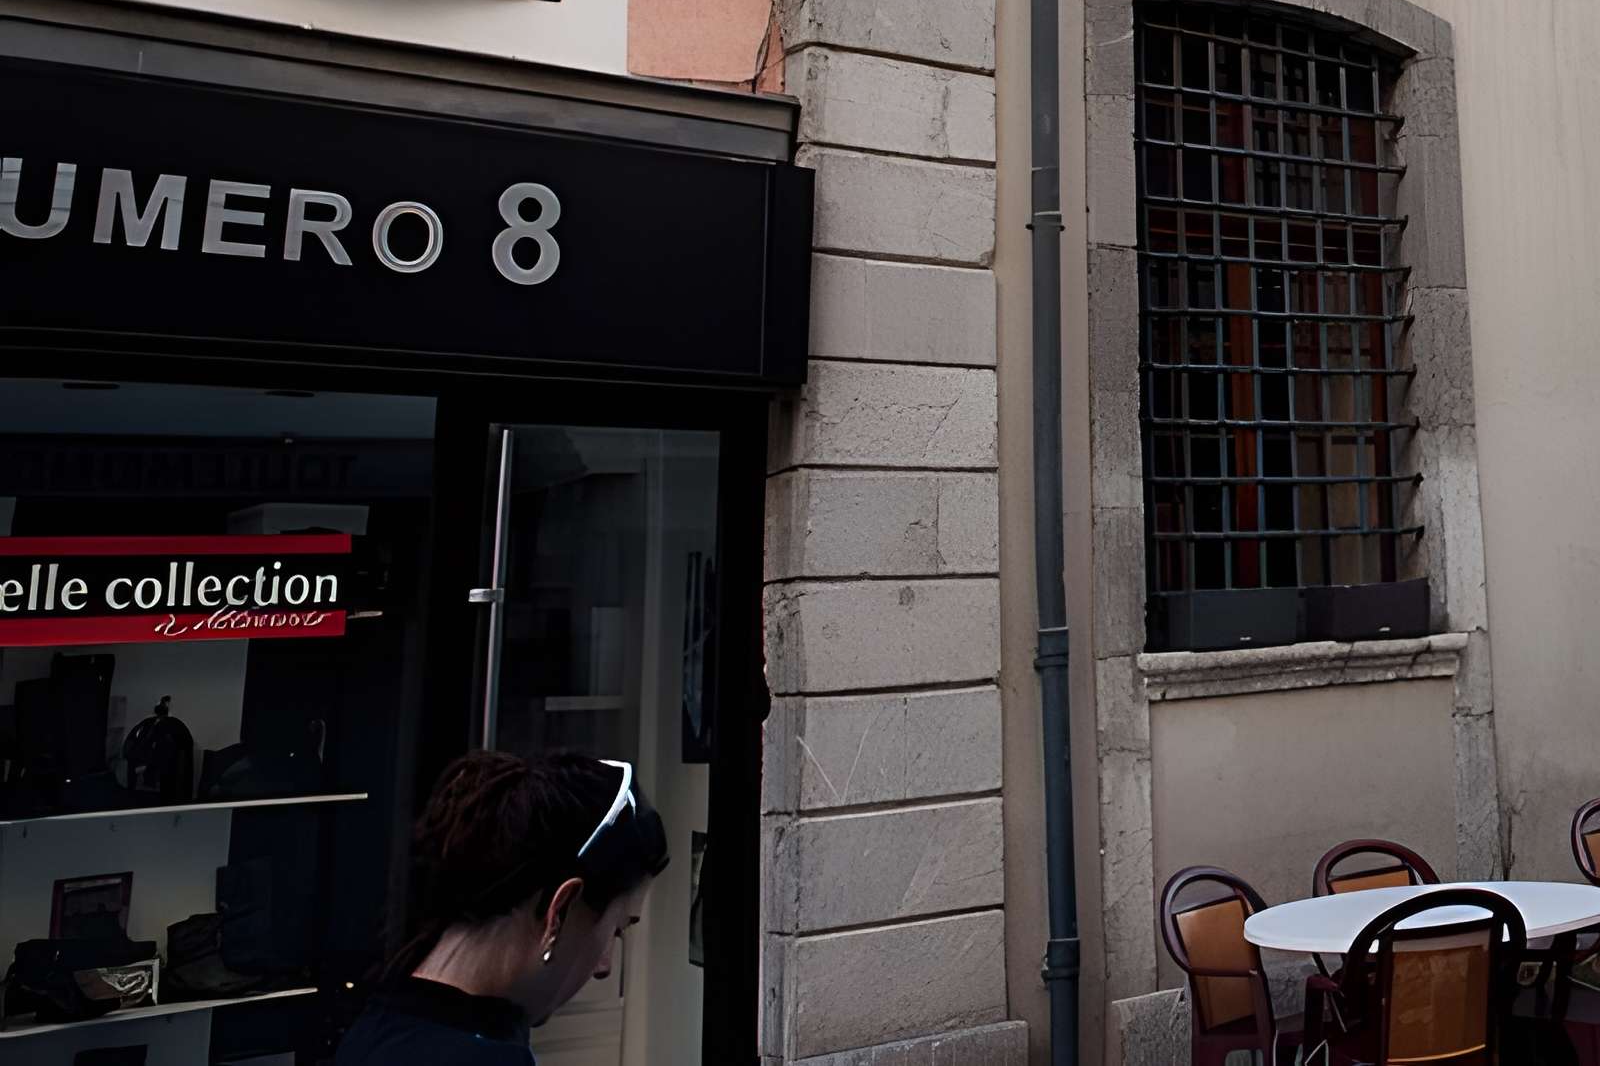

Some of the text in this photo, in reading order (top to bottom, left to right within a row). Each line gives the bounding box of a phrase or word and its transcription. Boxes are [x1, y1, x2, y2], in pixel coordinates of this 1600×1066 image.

[0, 157, 562, 285] UMERO 8
[0, 561, 338, 612] elle collection
